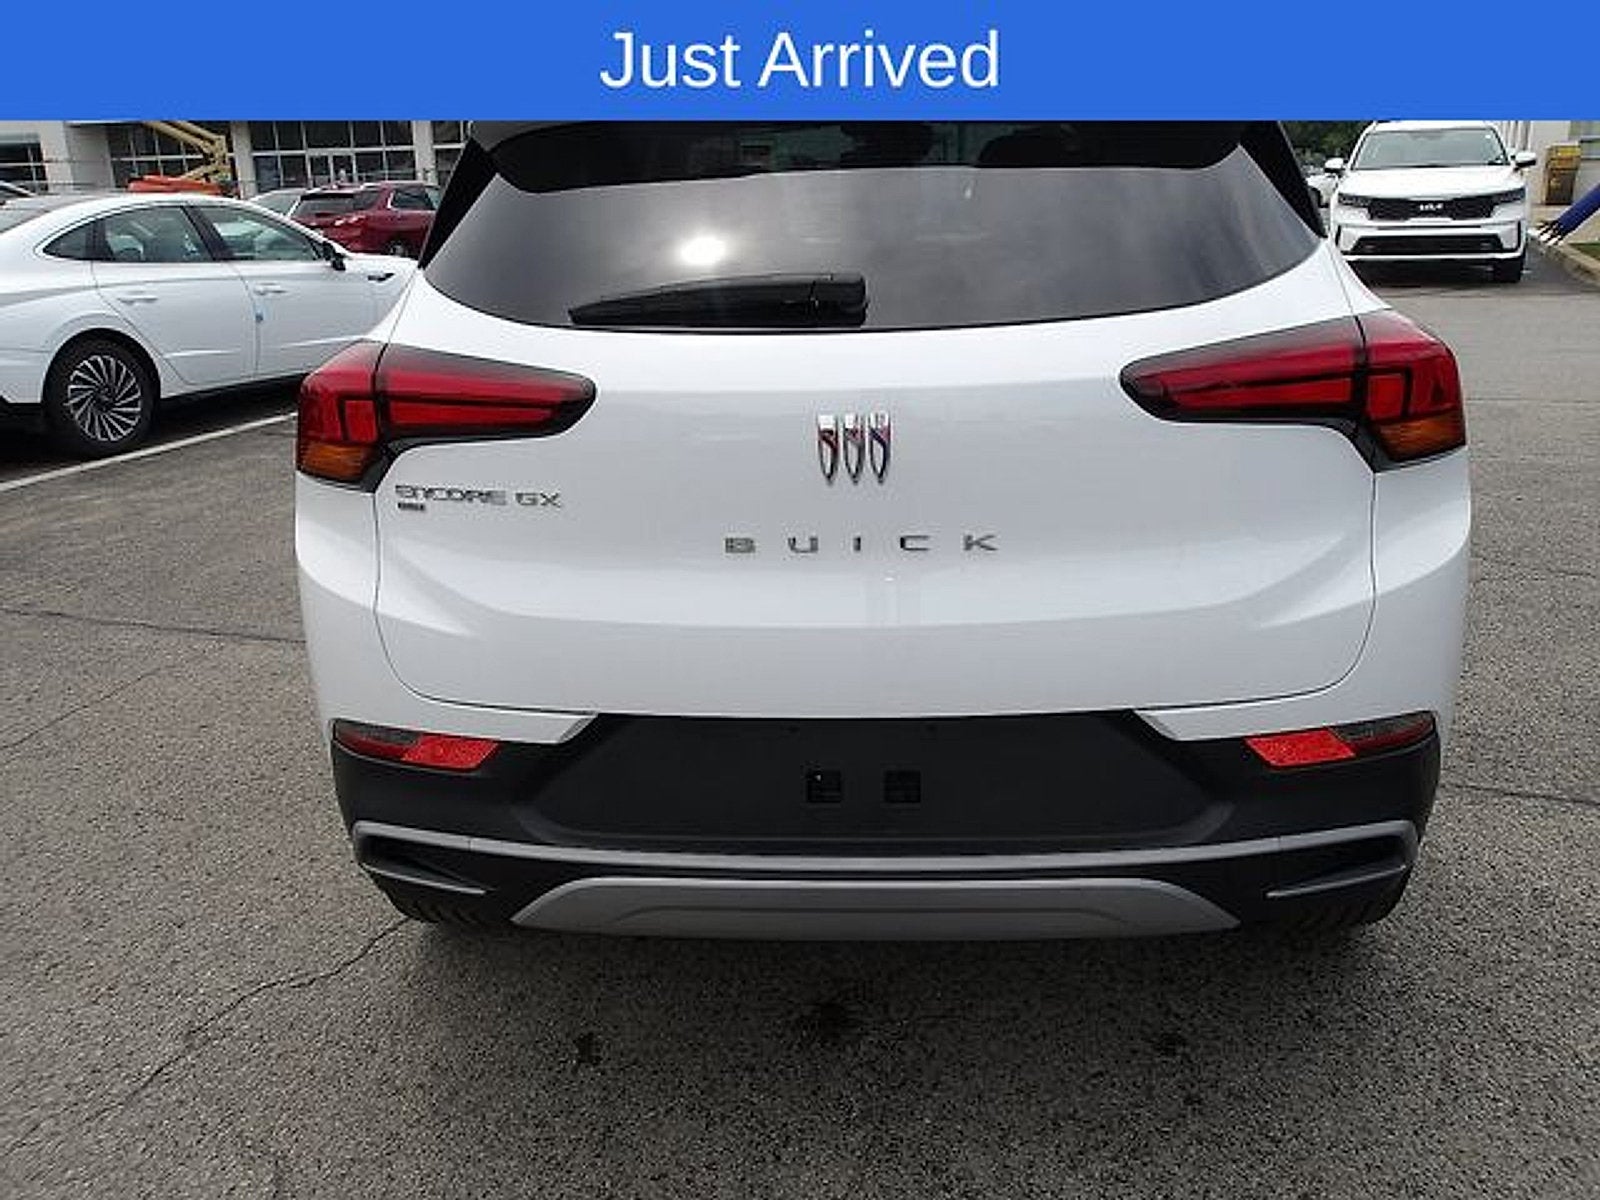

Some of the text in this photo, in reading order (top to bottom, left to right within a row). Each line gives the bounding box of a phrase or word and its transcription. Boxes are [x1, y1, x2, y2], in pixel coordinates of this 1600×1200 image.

[395, 484, 562, 508] ENCORE GX
[725, 534, 998, 554] BUICK
